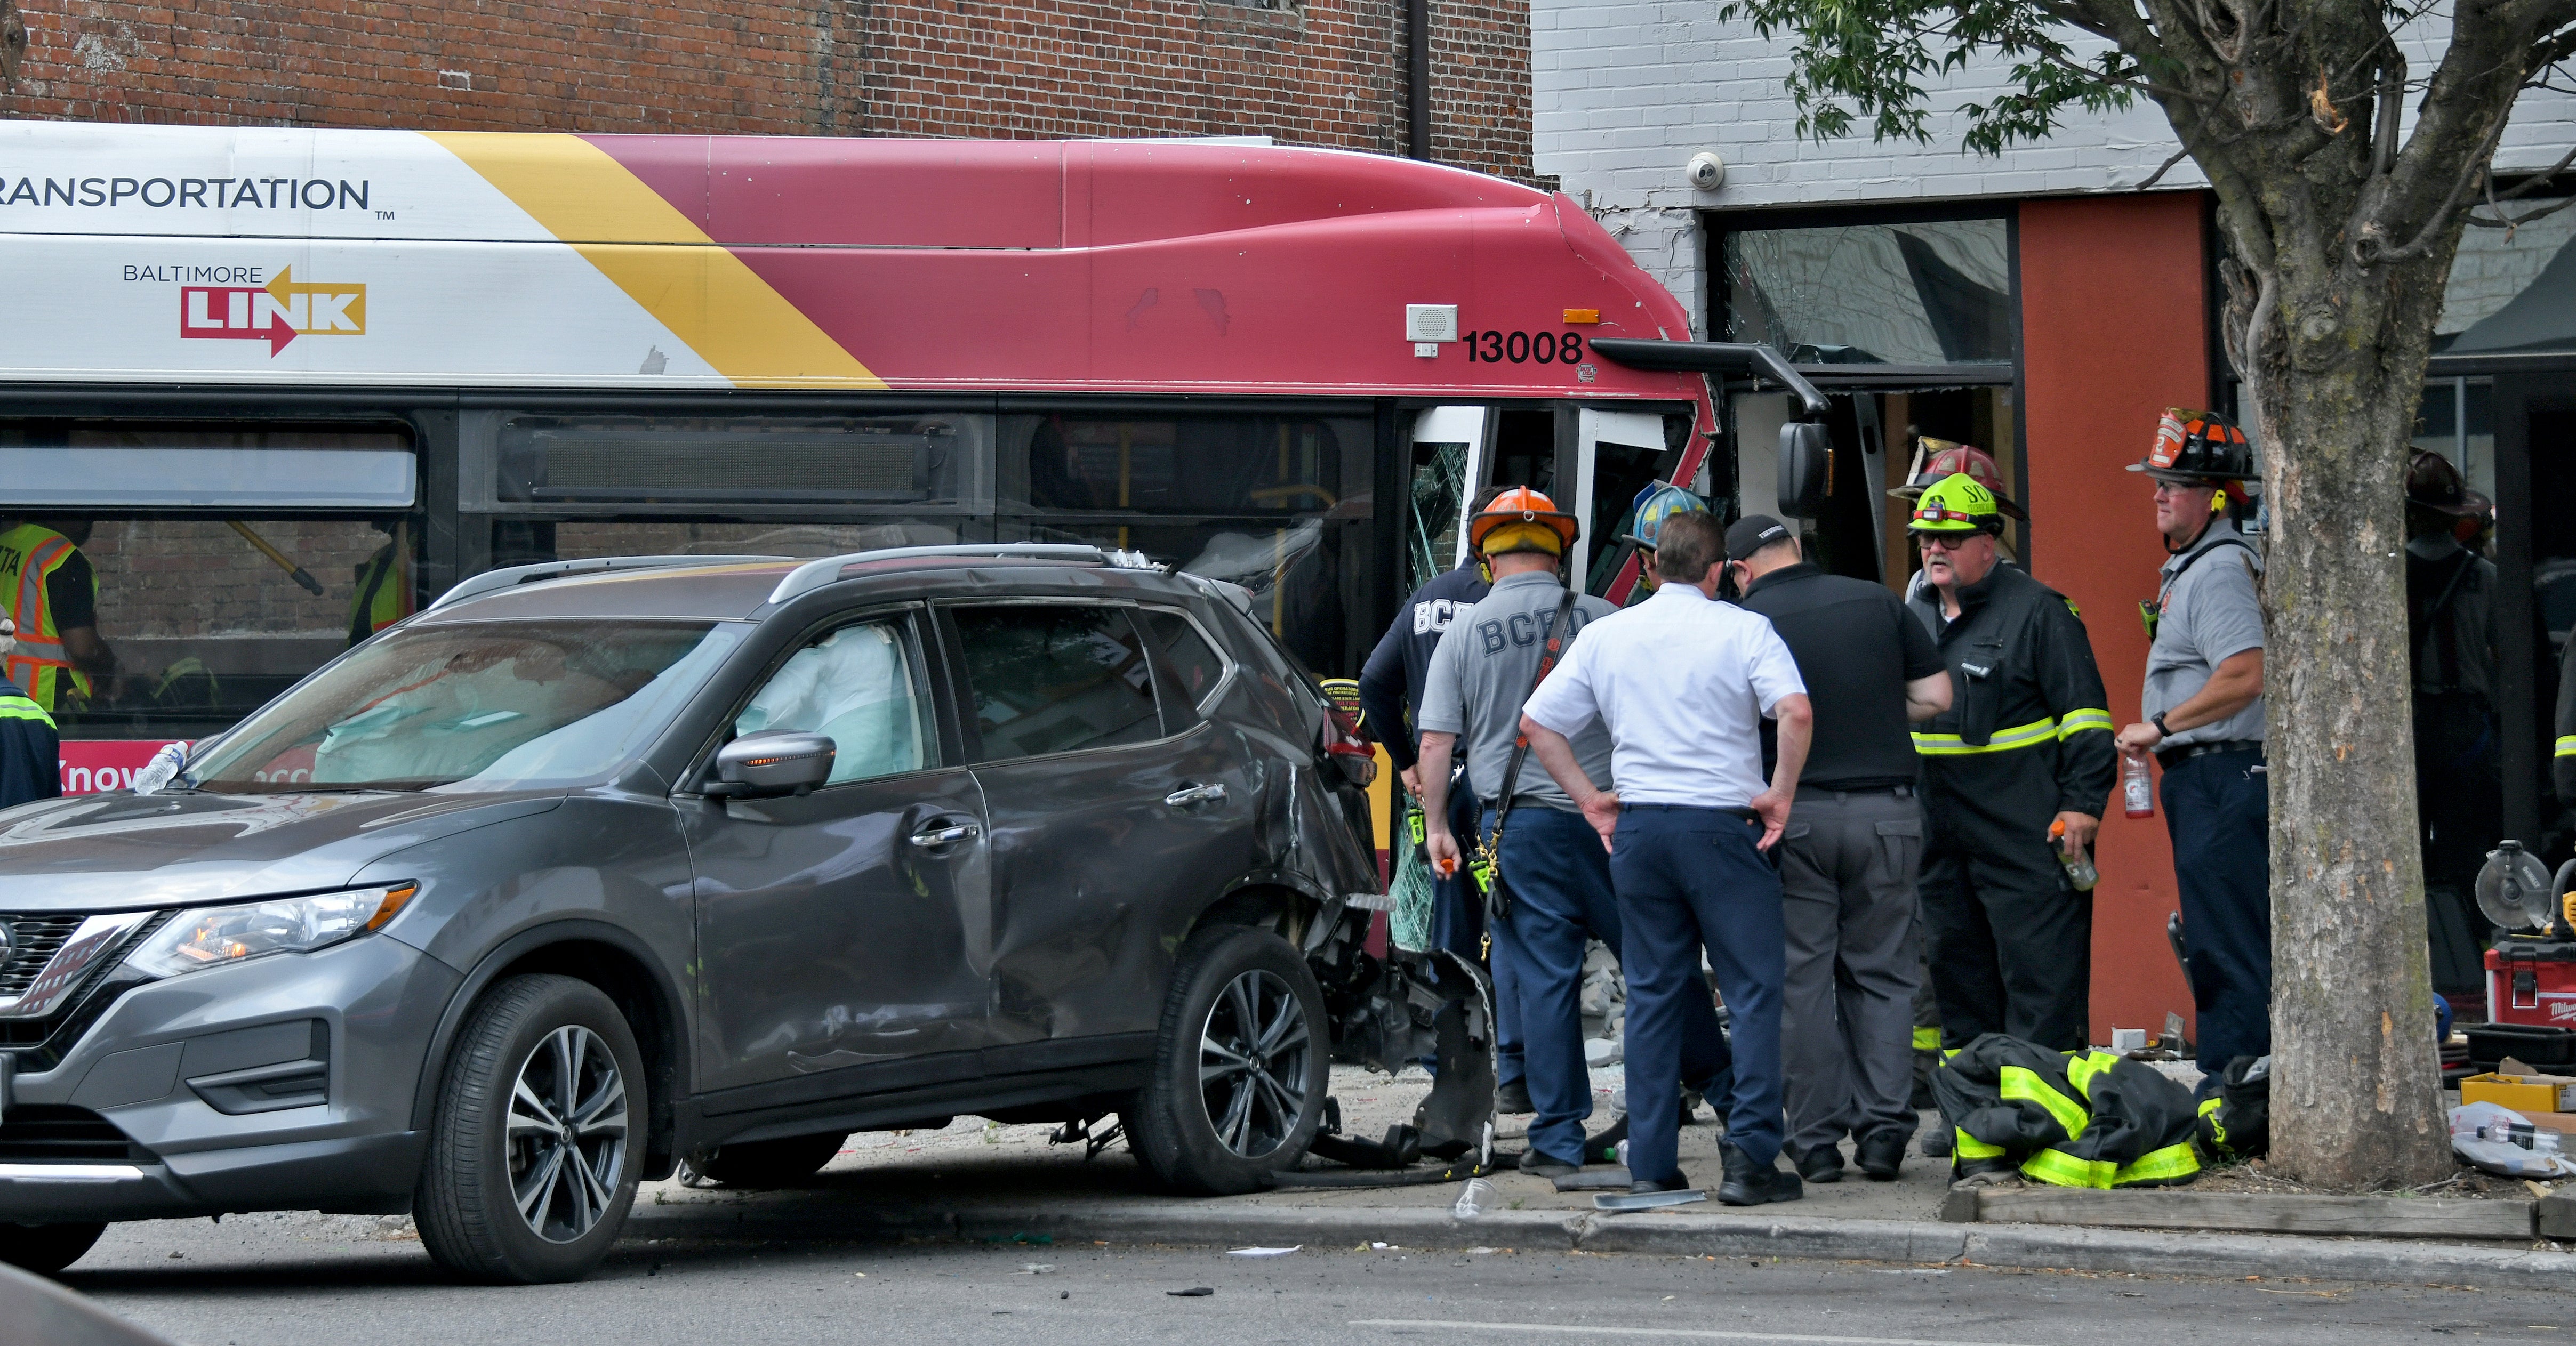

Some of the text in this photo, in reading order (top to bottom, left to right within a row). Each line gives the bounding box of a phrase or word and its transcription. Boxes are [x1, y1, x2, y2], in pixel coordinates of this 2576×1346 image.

[375, 211, 395, 220] TM
[124, 265, 263, 283] BALTIMORE
[188, 291, 361, 331] LINK
[1462, 330, 1583, 365] 13008
[2156, 436, 2166, 453] 2
[0, 545, 22, 576] TA
[1476, 605, 1592, 658] BCFD
